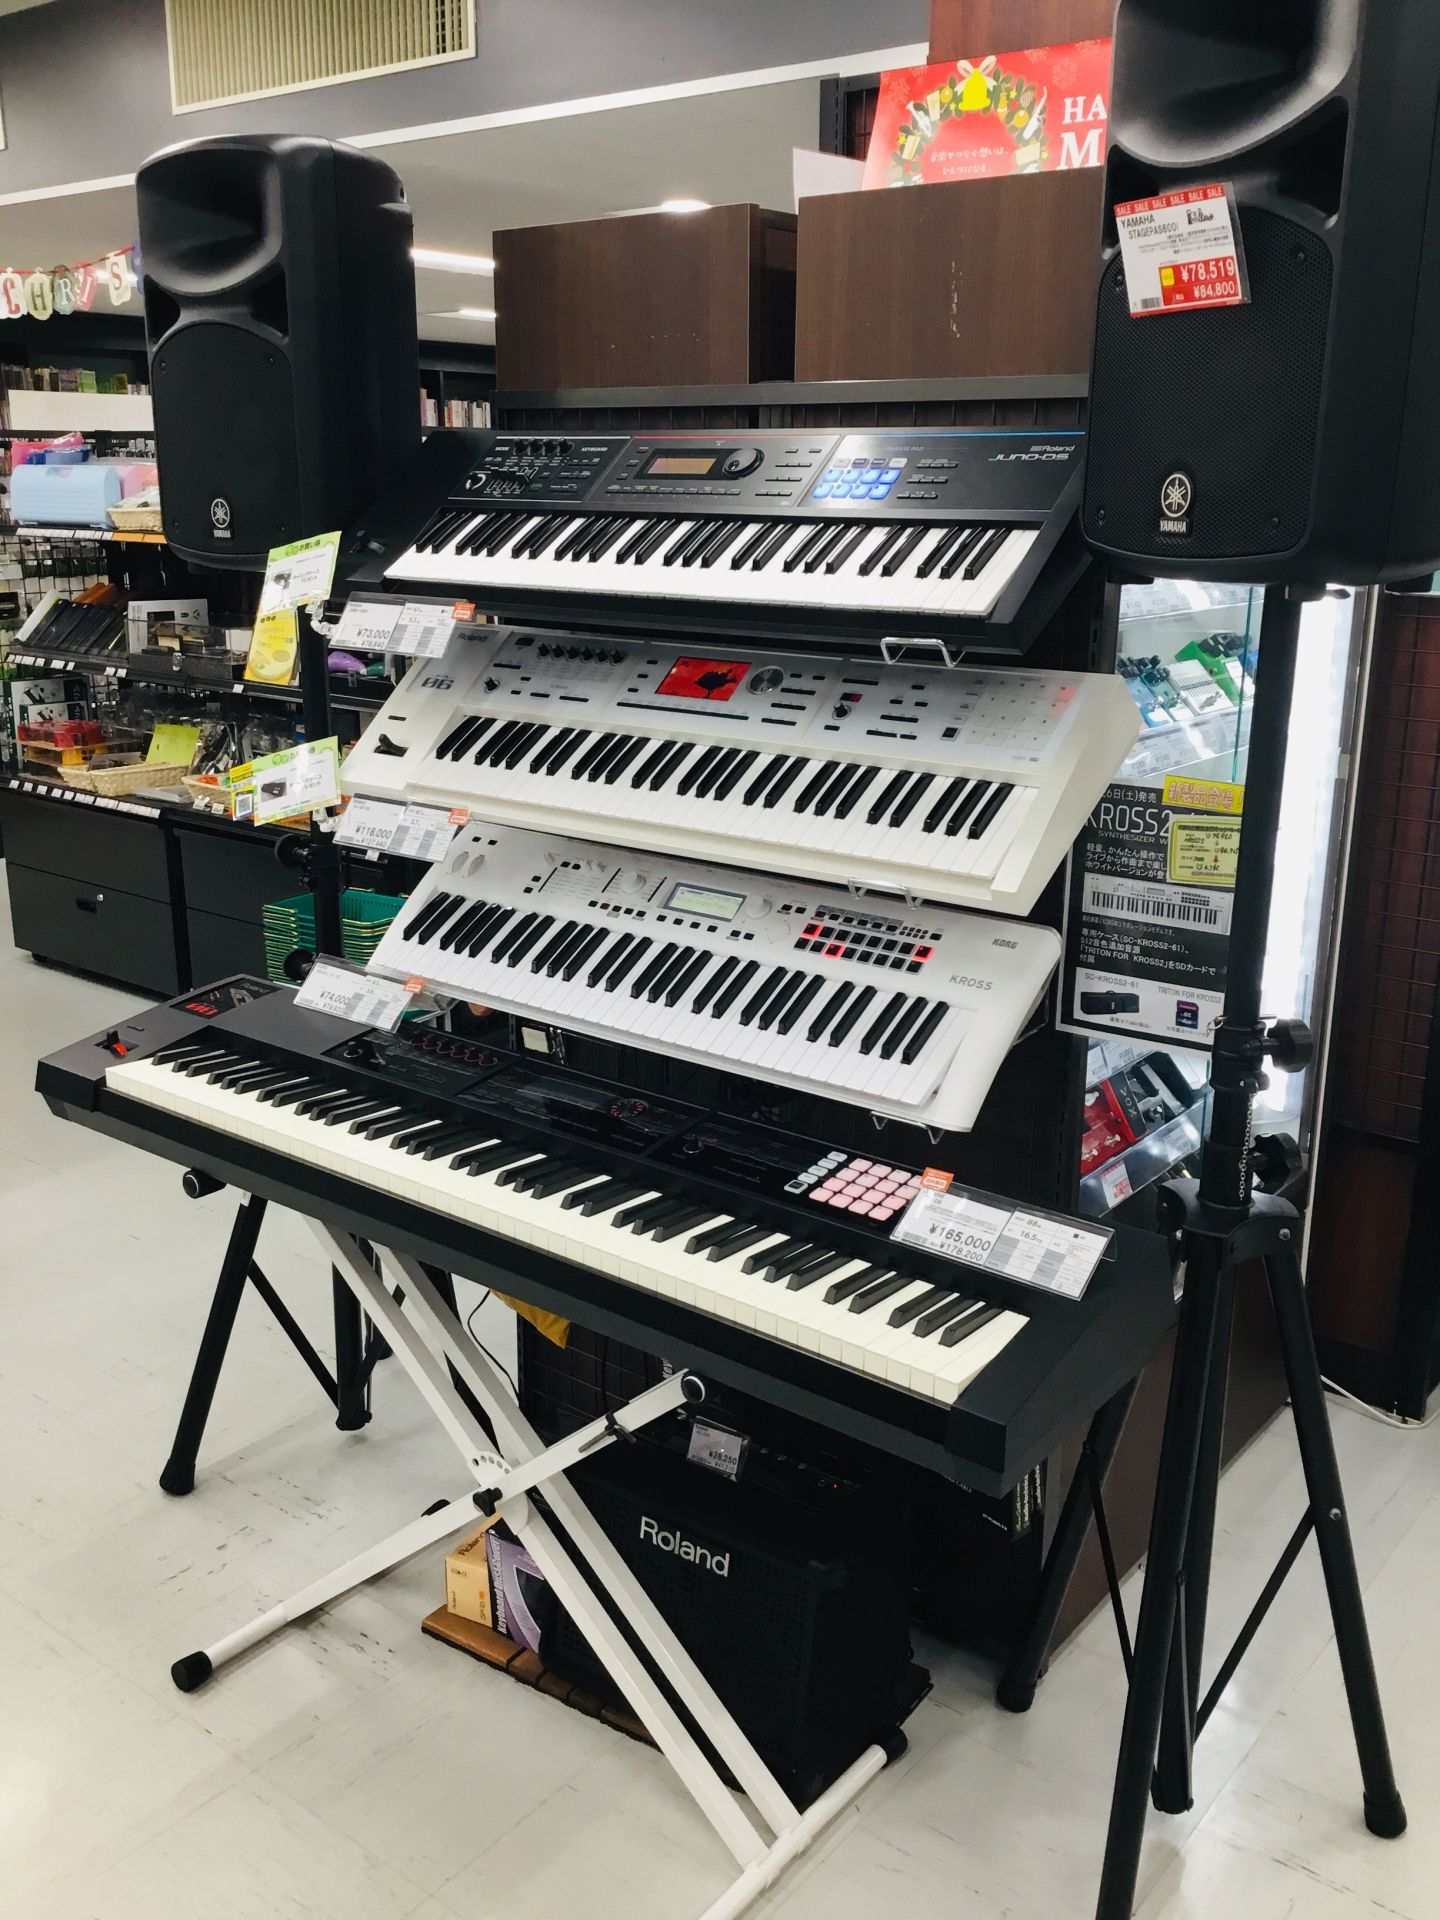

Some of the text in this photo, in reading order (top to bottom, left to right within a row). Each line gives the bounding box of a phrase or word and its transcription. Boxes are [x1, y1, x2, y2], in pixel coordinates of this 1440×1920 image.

[1116, 187, 1222, 215] SALE SALE SALE SALE SALE SALE
[1120, 214, 1155, 229] YAMAHA
[988, 453, 1070, 461] JUNO-DS
[1160, 519, 1187, 533] YAMAHA
[1098, 830, 1155, 843] SYNTHESIZER
[1086, 861, 1168, 880] ホワイトバージョンが登
[992, 938, 1019, 950] KORG
[1113, 950, 1129, 960] FOR
[949, 974, 993, 991] KROSS
[1084, 972, 1139, 989] SC-KROSS2-61
[1158, 986, 1181, 997] TRITON
[1182, 990, 1195, 999] FOR
[1119, 1087, 1137, 1117] VOX
[640, 1515, 730, 1578] Roland
